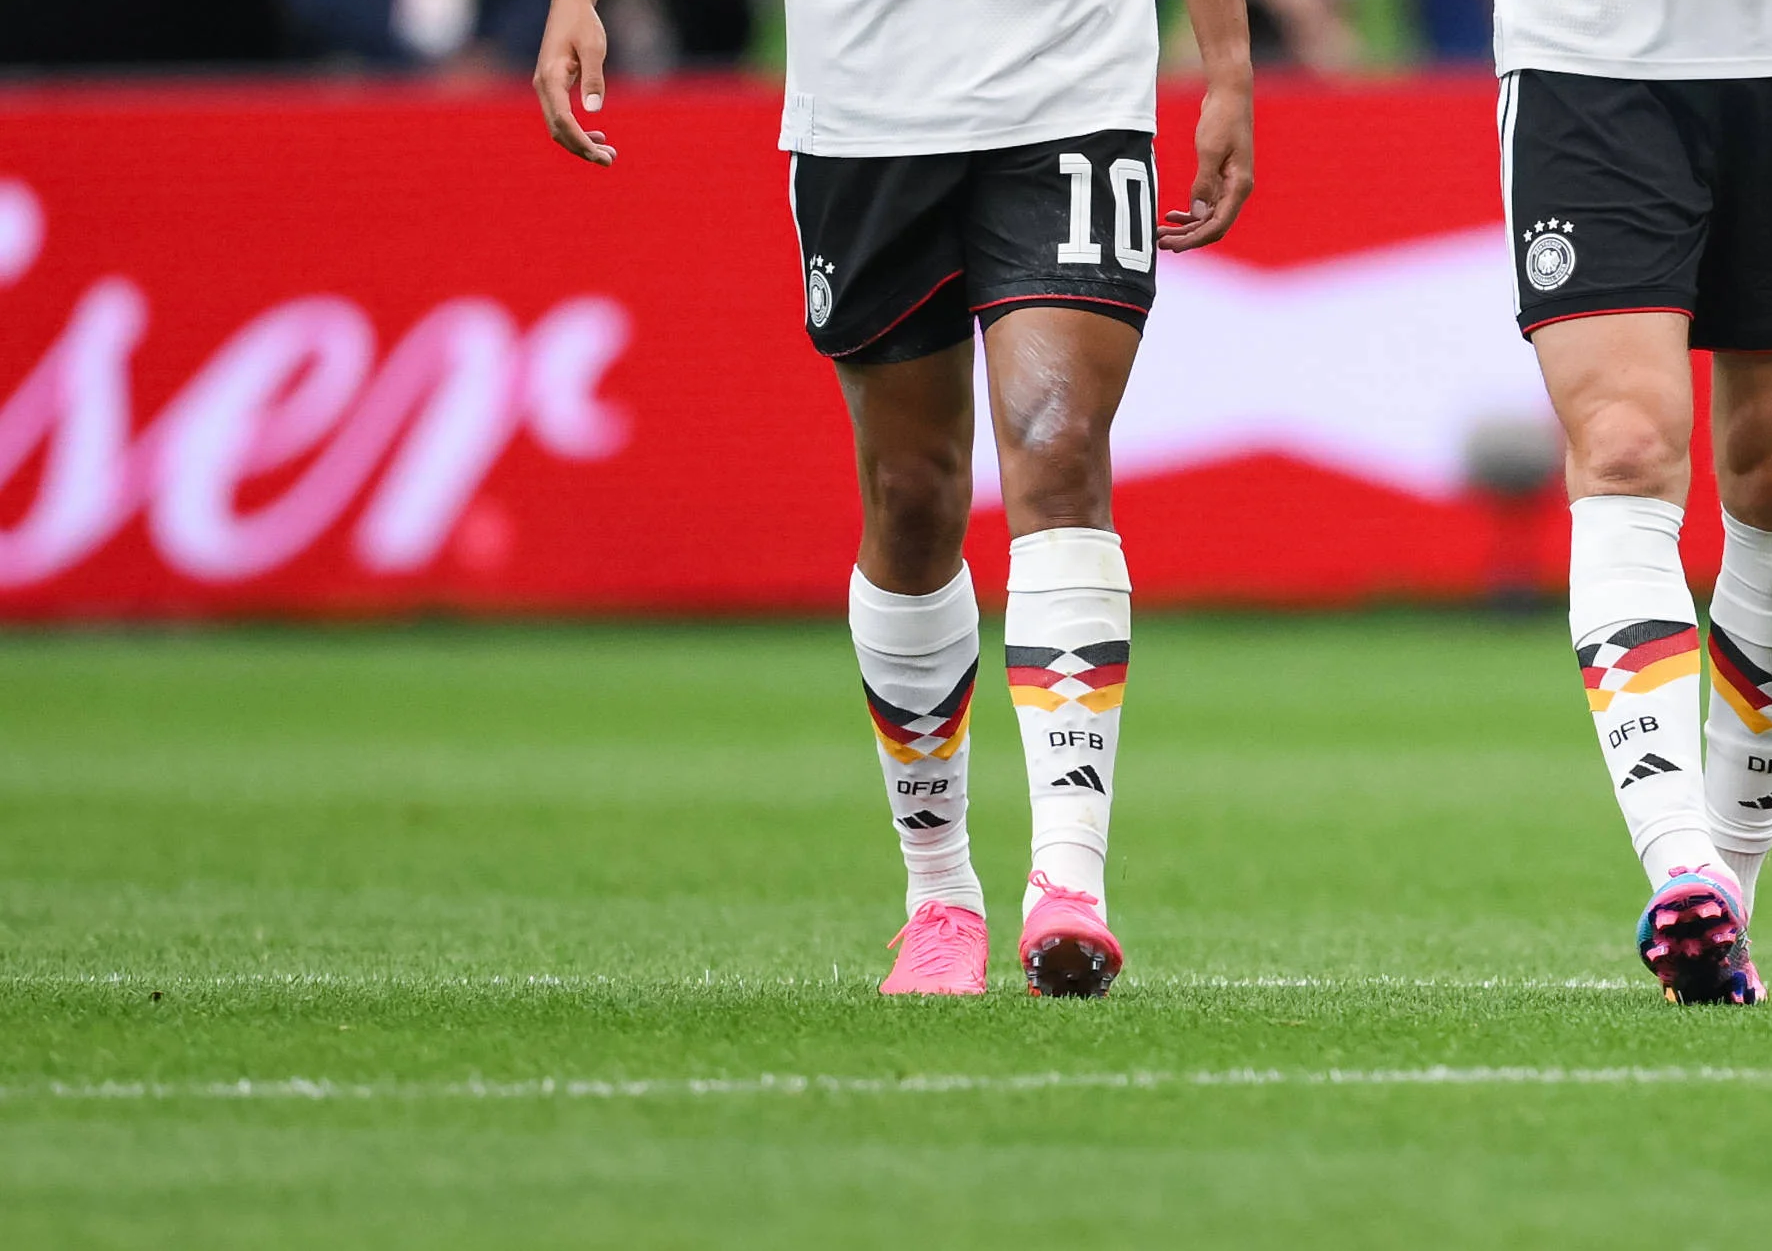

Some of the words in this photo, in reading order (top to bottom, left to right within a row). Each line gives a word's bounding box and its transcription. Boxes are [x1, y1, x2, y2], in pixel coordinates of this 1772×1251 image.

[1057, 152, 1154, 273] 10
[0, 177, 636, 587] ser
[1049, 731, 1104, 750] DFB
[1609, 715, 1660, 749] DFB
[897, 779, 949, 796] DFB
